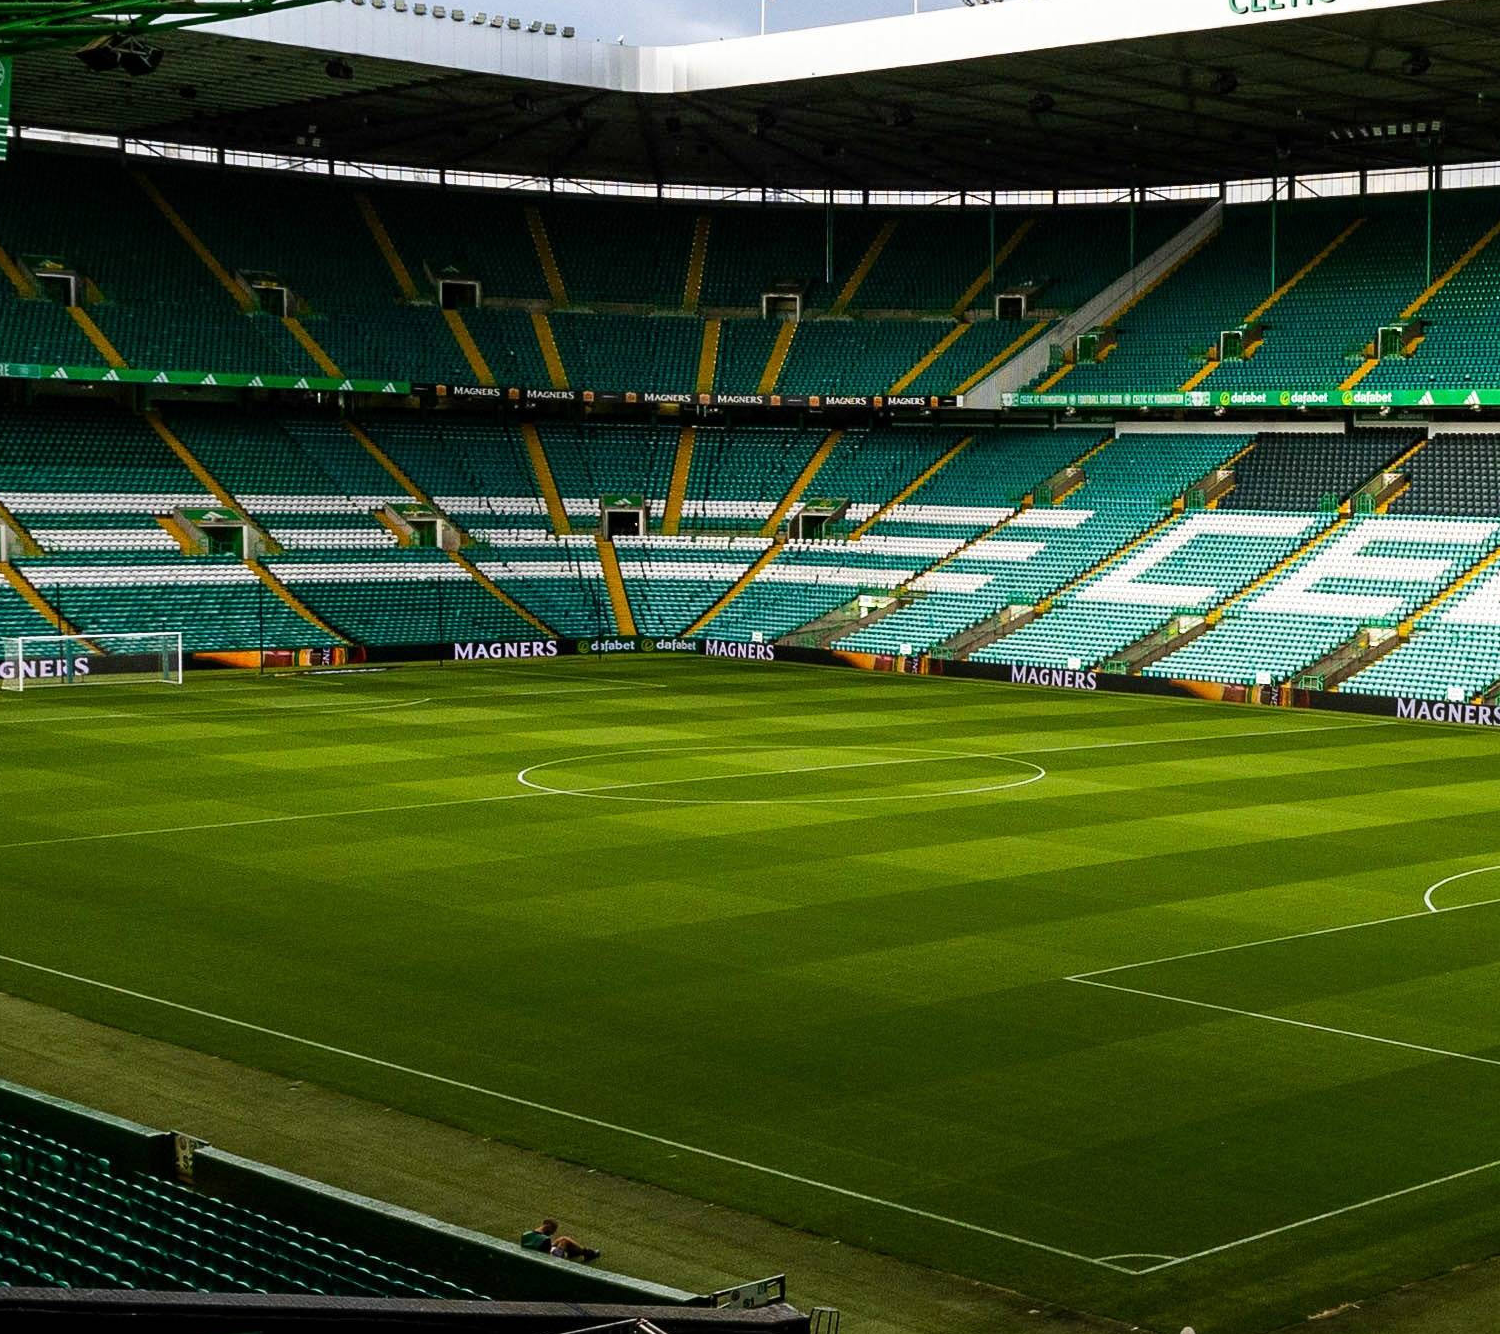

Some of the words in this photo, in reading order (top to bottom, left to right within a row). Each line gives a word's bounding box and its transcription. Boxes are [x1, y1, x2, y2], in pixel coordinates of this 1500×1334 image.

[454, 386, 500, 397] MAGNERS
[527, 389, 574, 400] MAGNERS
[1231, 391, 1266, 404] dafabet
[1291, 391, 1328, 404] dafabet
[1354, 391, 1392, 404] dafabet
[644, 393, 691, 403] MAGNERS
[718, 395, 762, 404] MAGNERS
[826, 396, 866, 405] MAGNERS
[888, 396, 925, 406] MAGNERS
[454, 640, 558, 660] MAGNERS
[591, 640, 635, 653] dafabet
[655, 639, 696, 651] dafabet
[705, 639, 774, 661] MAGNERS
[1011, 666, 1097, 691] MAGNERS
